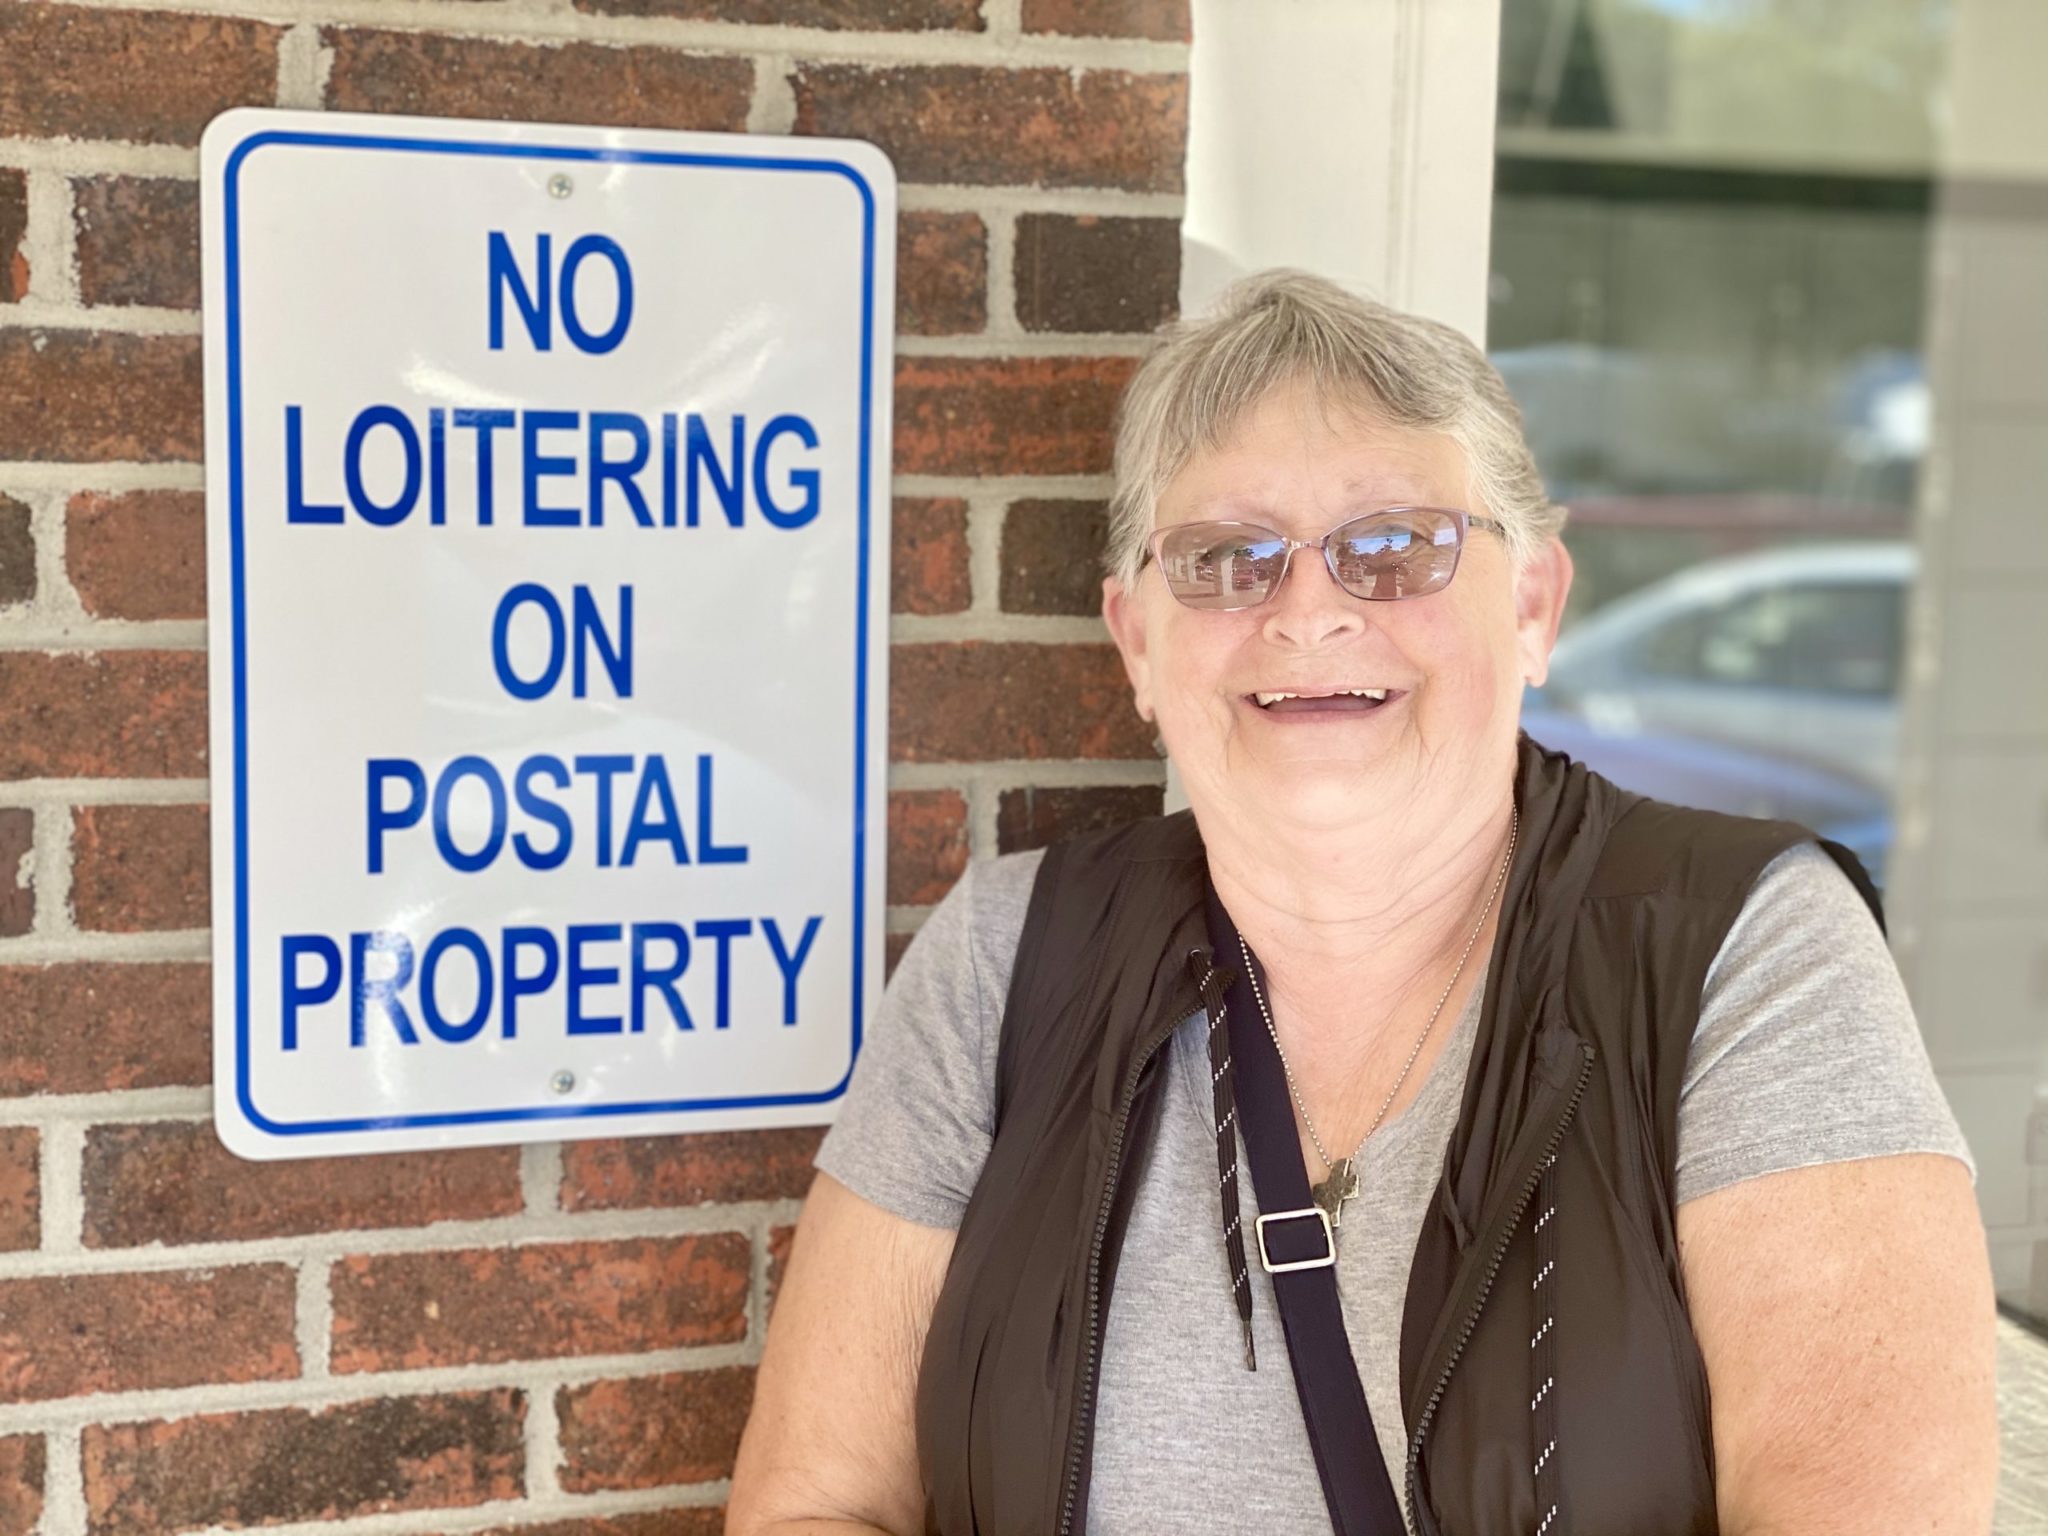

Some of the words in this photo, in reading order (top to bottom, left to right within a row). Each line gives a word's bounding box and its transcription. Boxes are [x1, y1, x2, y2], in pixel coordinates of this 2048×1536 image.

[488, 231, 634, 355] NO
[285, 405, 822, 531] LOITERING
[491, 582, 633, 701] ON
[367, 753, 749, 876] POSTAL
[280, 916, 823, 1052] PROPERTY
